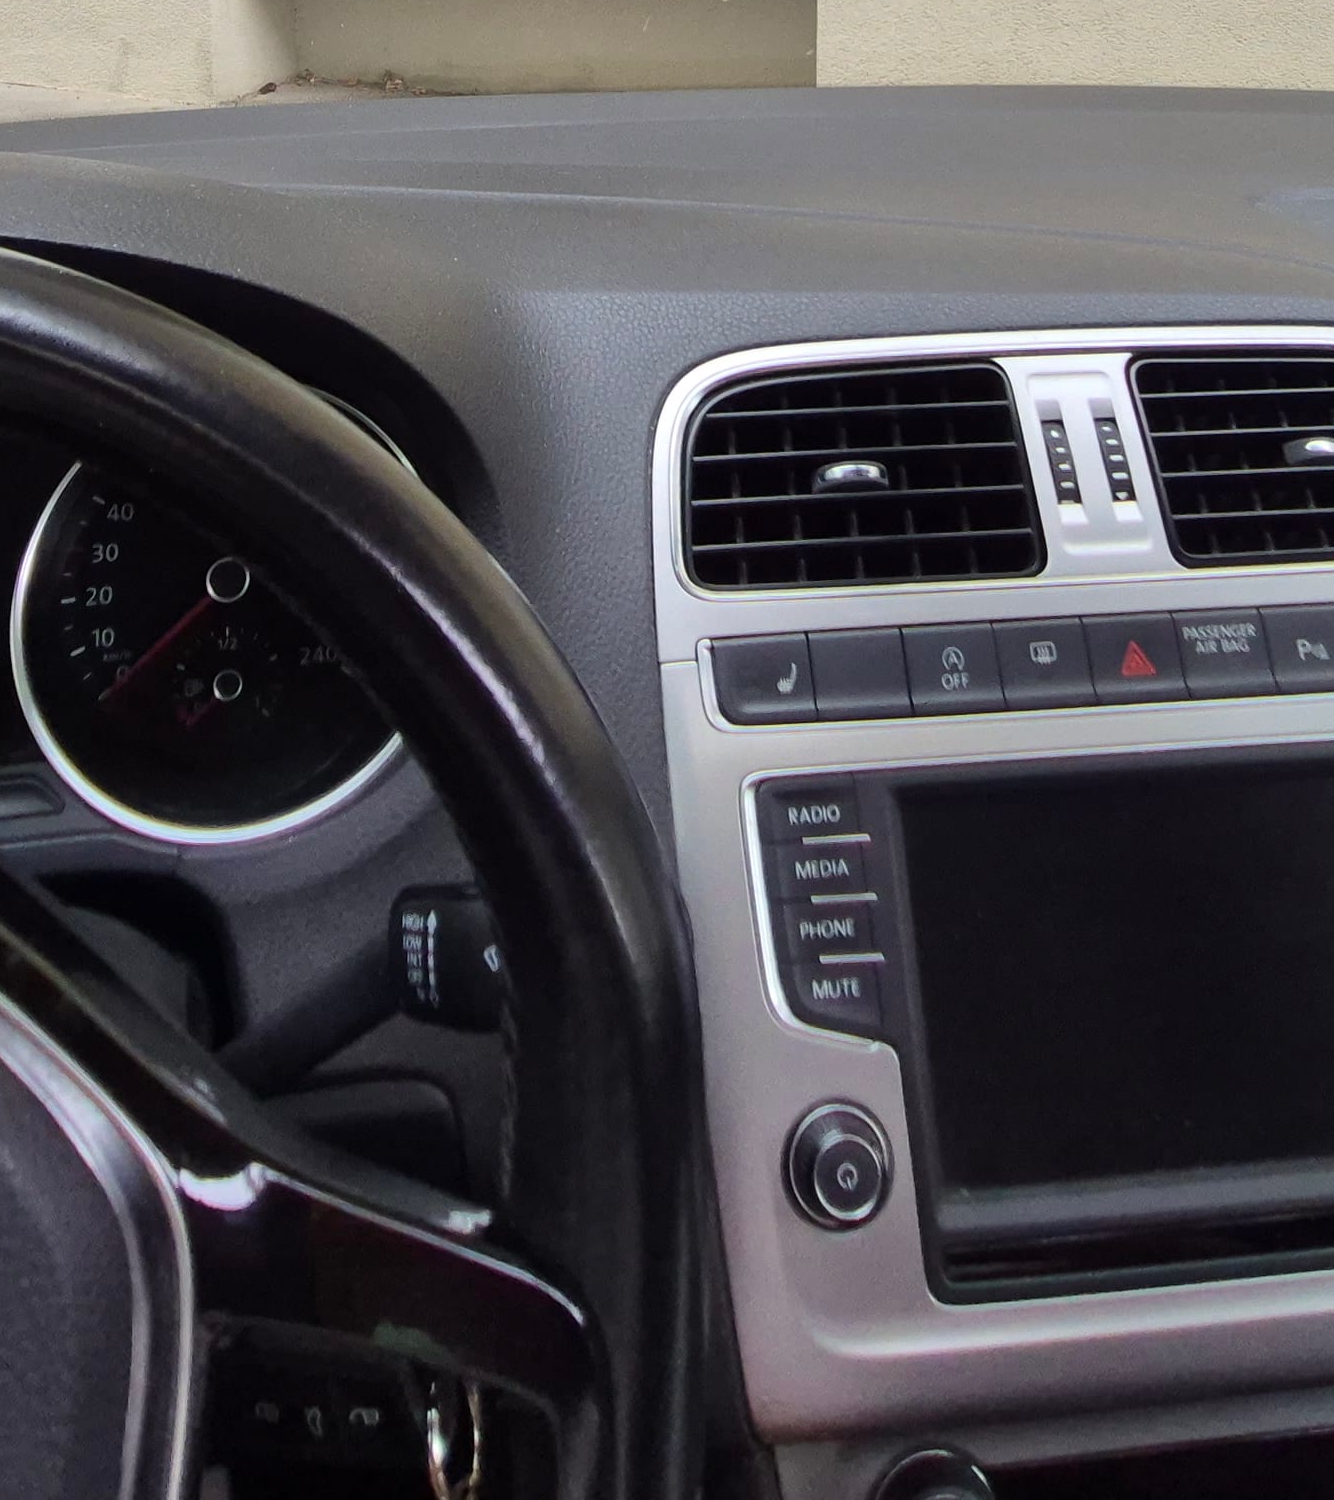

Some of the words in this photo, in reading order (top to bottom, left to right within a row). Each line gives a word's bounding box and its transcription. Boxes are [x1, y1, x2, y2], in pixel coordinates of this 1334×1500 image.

[106, 503, 135, 522] 40
[91, 543, 119, 563] 30
[85, 585, 114, 606] 20
[92, 628, 115, 648] 10
[1181, 622, 1257, 641] PASSENGER
[1195, 640, 1218, 655] AIR
[1220, 638, 1250, 653] BAG
[941, 672, 971, 690] OFF
[788, 804, 841, 825] RADIO
[794, 858, 850, 880] MEDIA
[799, 918, 855, 940] PHONE
[811, 976, 861, 999] MUTE
